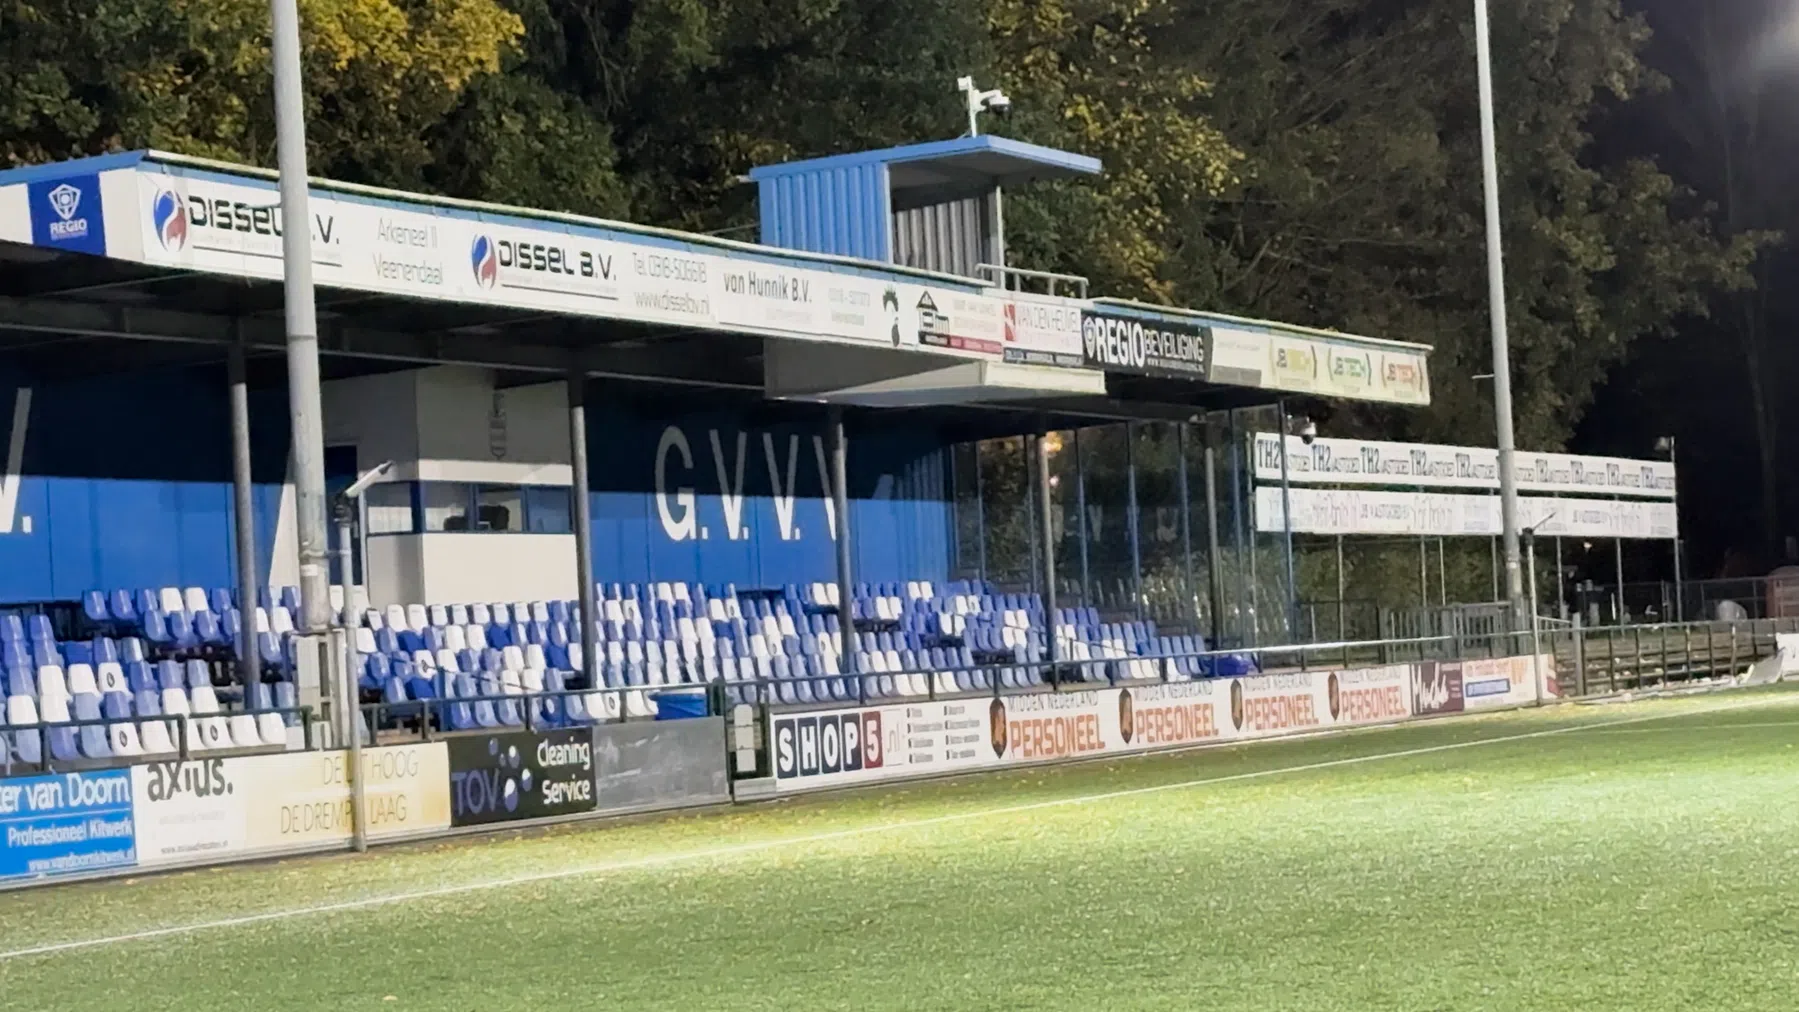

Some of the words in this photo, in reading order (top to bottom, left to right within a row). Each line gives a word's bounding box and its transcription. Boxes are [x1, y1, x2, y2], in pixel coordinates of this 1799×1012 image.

[50, 218, 88, 234] REGIO
[372, 252, 444, 285] Veenendaal
[579, 250, 617, 281] B.V.
[723, 272, 745, 294] van
[748, 270, 789, 300] Hunnik
[791, 277, 813, 303] B.V.
[1095, 317, 1145, 368] REGIO
[1143, 328, 1205, 362] BEVEILIGING
[1244, 694, 1320, 732] PERSONEEL
[1341, 686, 1408, 721] PERSONEEL
[1009, 713, 1105, 759] PERSONEEL
[1135, 703, 1220, 744] PERSONEEL
[323, 756, 342, 785] DE
[371, 750, 419, 780] HOOG
[536, 735, 591, 771] Cleaning
[25, 781, 65, 811] van
[66, 772, 131, 807] Doorn
[451, 768, 500, 817] TOV
[541, 774, 591, 805] Service
[280, 804, 300, 834] DE
[370, 794, 407, 825] LAAG
[8, 819, 88, 848] Professioneel
[89, 817, 134, 839] Kitwerk
